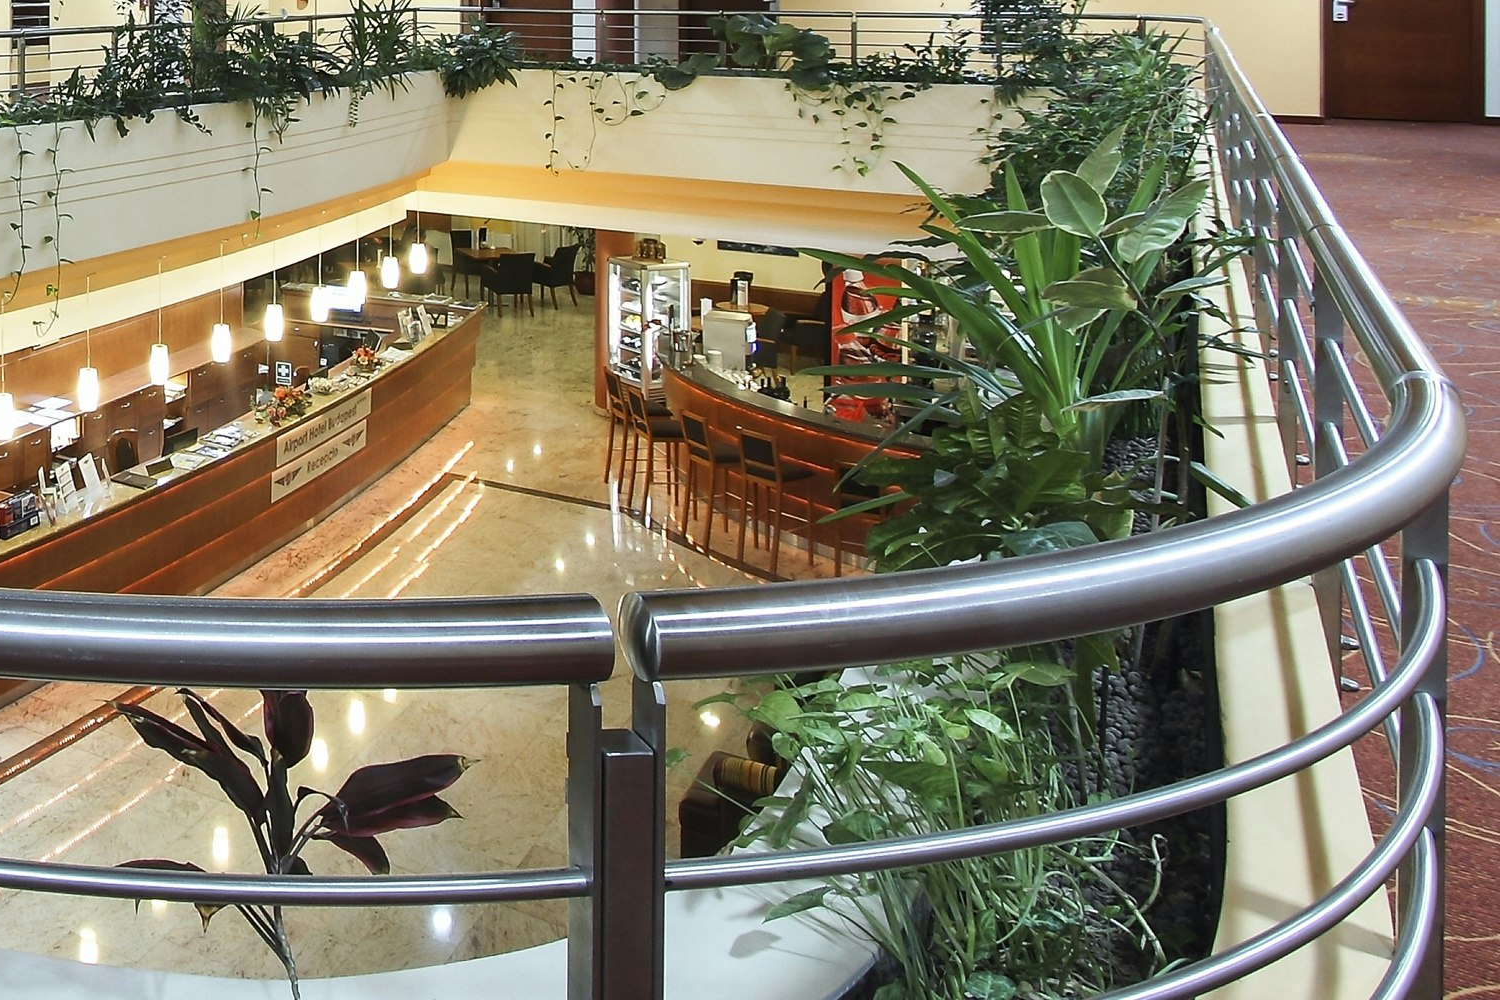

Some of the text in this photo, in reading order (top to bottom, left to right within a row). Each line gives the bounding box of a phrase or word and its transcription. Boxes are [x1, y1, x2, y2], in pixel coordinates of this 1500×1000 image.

[283, 404, 357, 454] Airport Hotel Budapest
